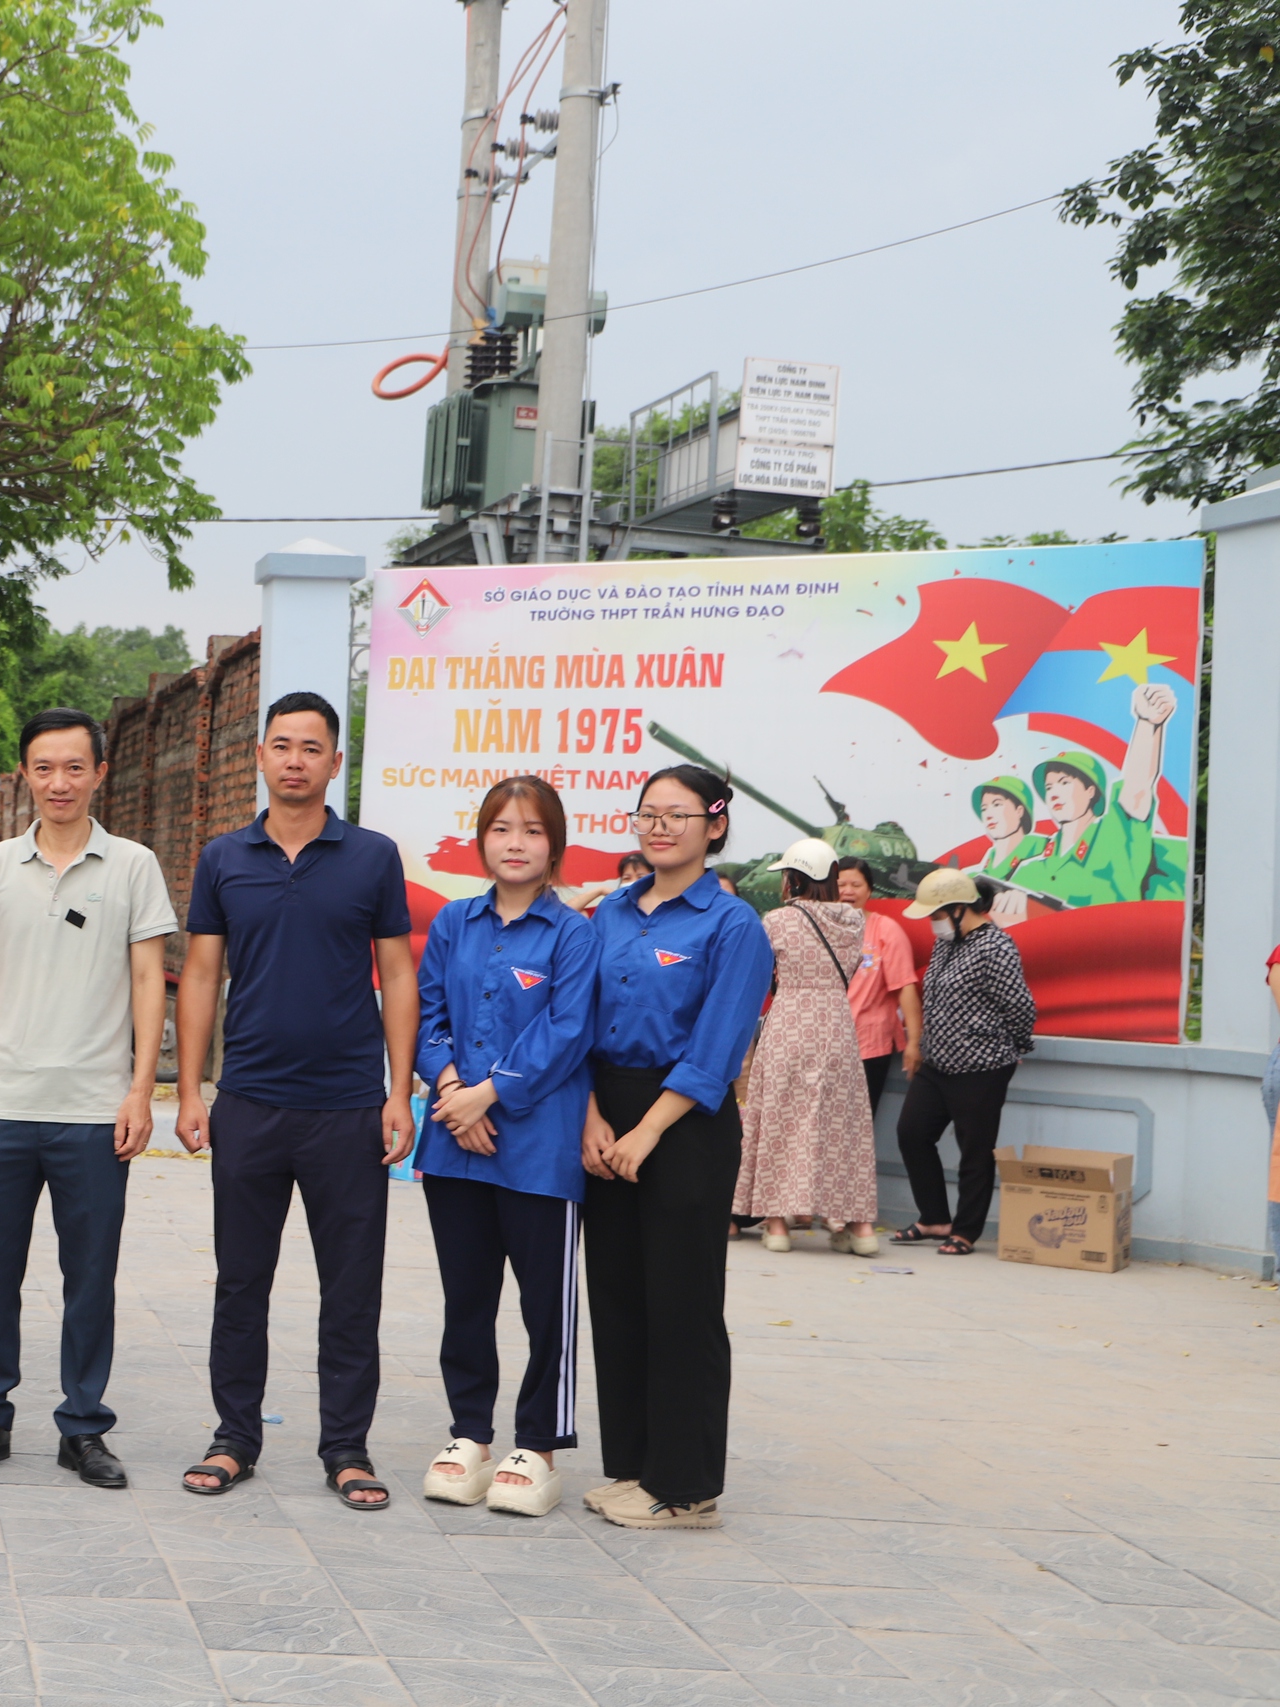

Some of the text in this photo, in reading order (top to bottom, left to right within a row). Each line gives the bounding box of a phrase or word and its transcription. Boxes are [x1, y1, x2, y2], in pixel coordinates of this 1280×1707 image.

[750, 459, 771, 471] CÔNG
[774, 462, 782, 471] TY
[484, 581, 839, 604] SỞ GIÁO DỤC VÀ ĐÀO TẠO TỈNH NAM ĐỊNH
[530, 606, 595, 622] TRƯỜNG
[601, 608, 638, 620] THPT
[691, 605, 739, 619] HƯNG
[746, 605, 784, 621] ĐẠO
[387, 642, 724, 697] ĐẠI THẮNG MÙA XUÂN
[453, 699, 643, 755] NĂM 1975
[382, 763, 436, 788] SỨC
[586, 770, 649, 791] NAM
[573, 808, 634, 834] THỜ
